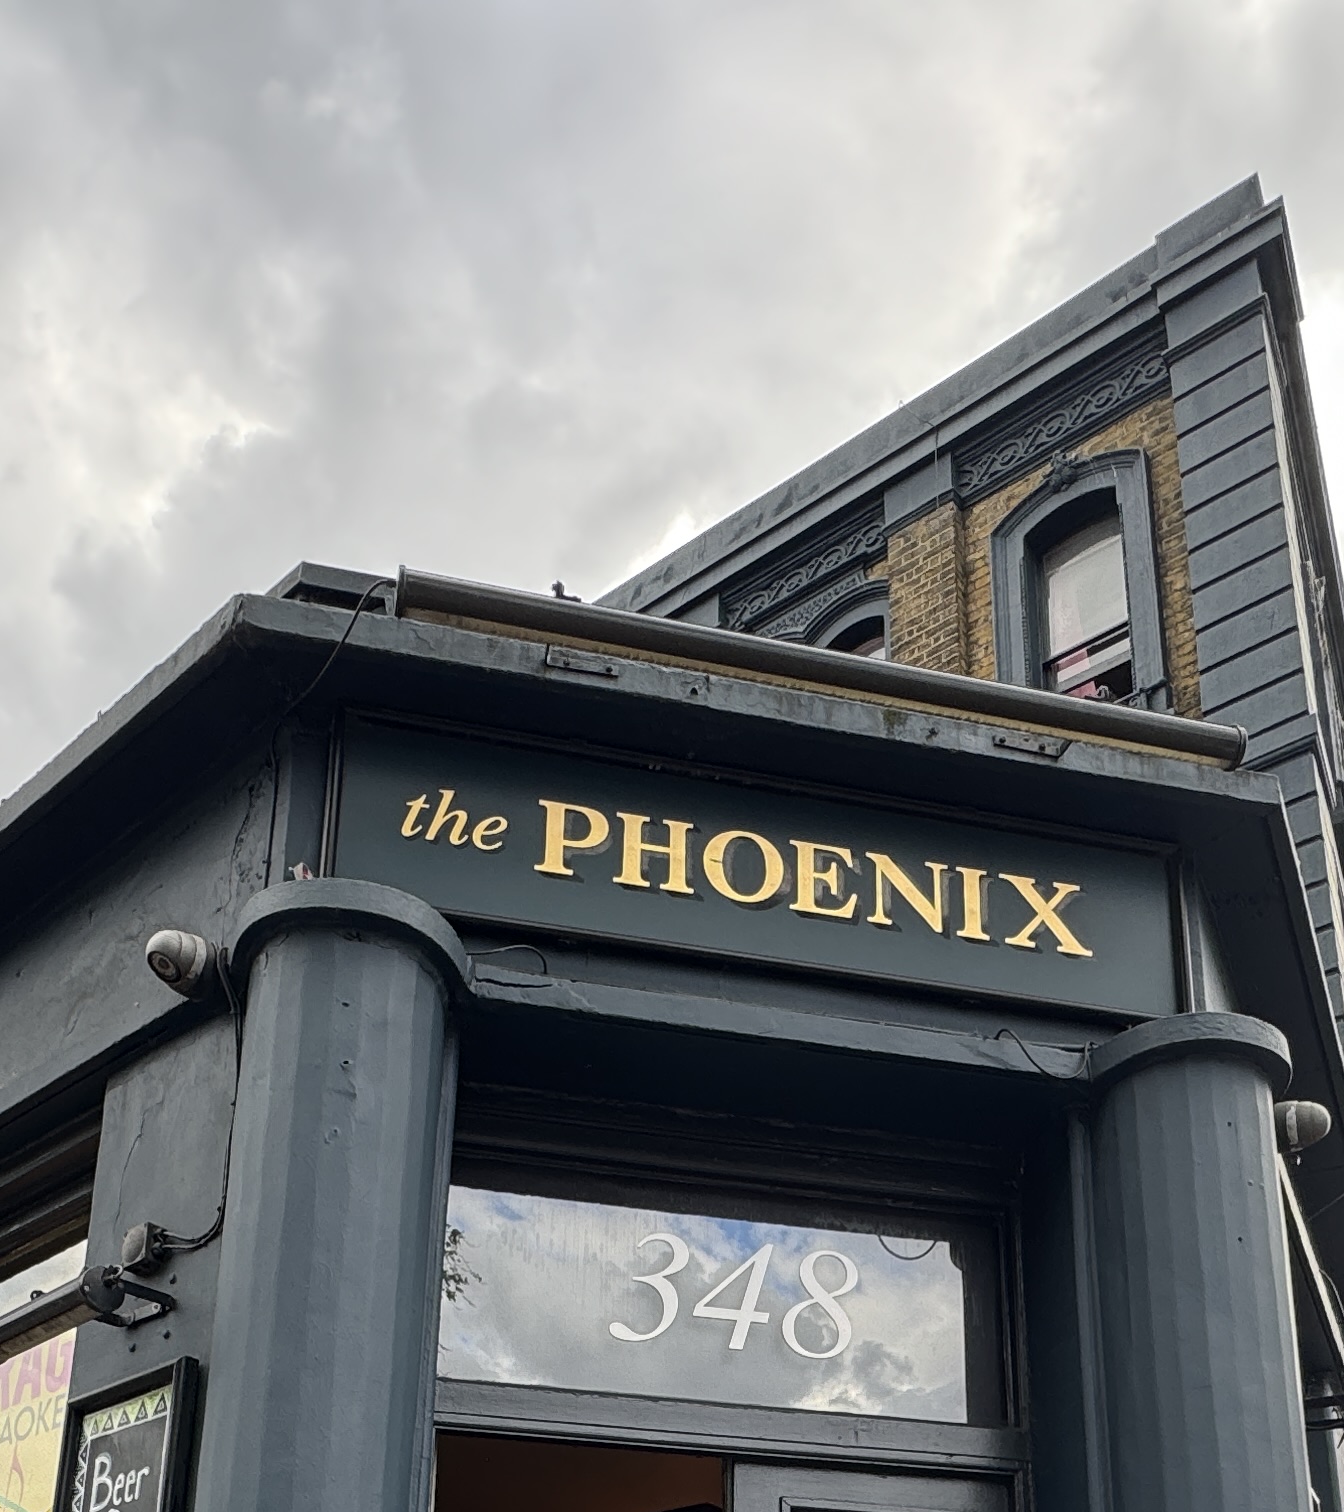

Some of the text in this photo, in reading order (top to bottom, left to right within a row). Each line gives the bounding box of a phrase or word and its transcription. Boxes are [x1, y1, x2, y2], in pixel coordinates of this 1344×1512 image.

[399, 788, 1094, 958] the PHOENIX
[608, 1232, 859, 1360] 348
